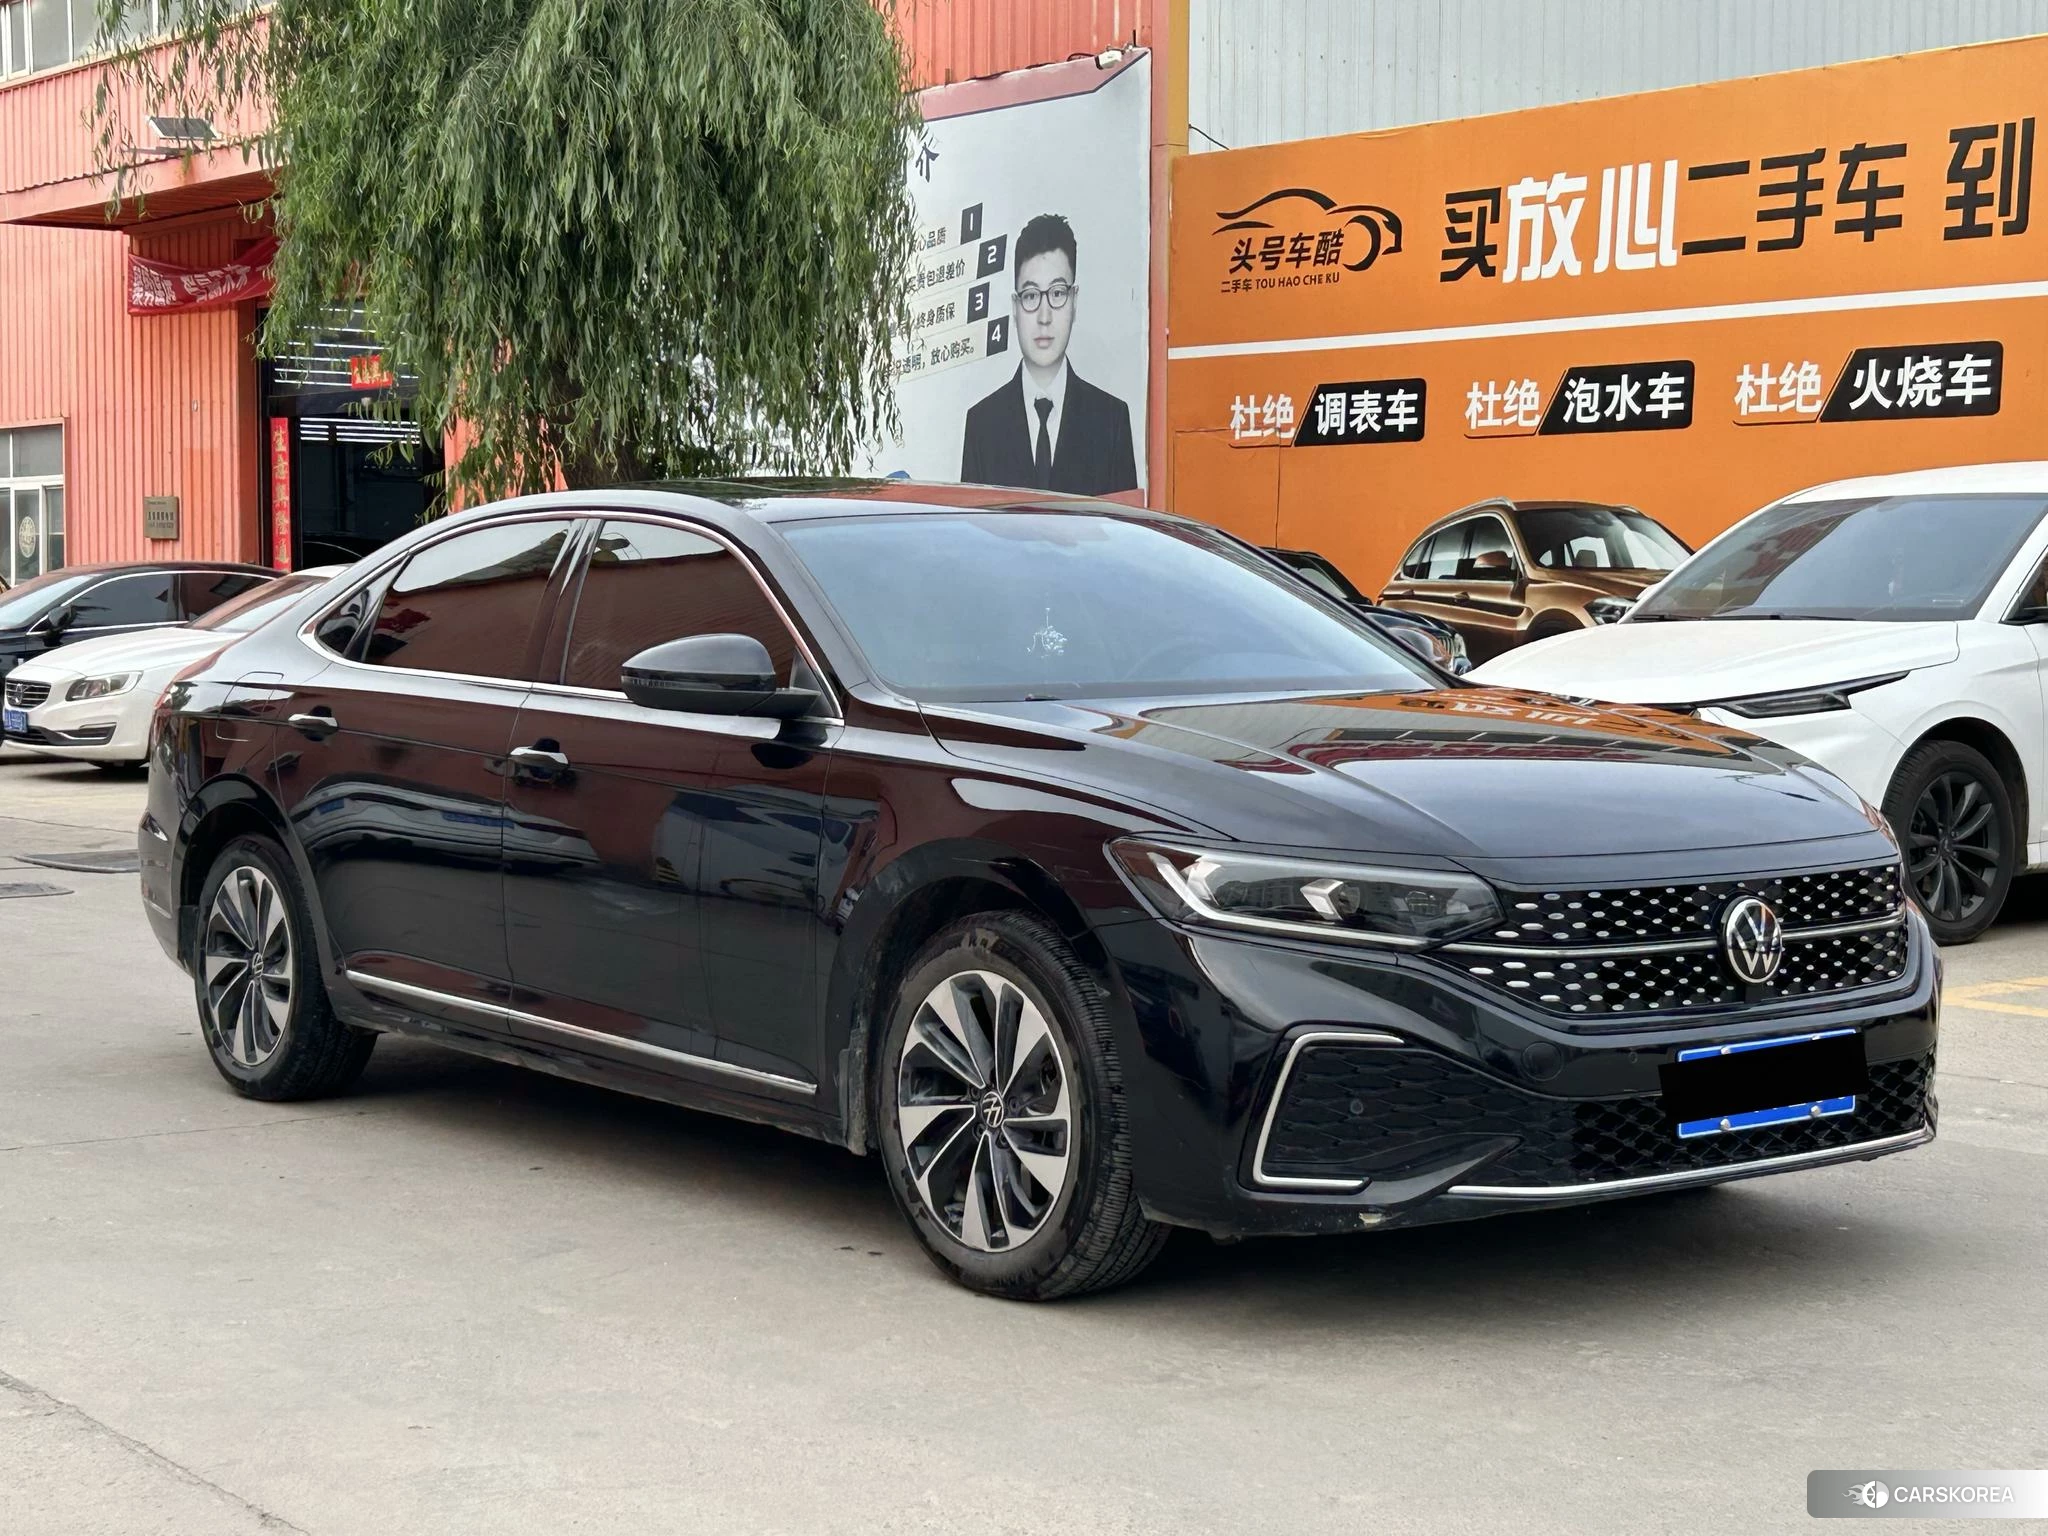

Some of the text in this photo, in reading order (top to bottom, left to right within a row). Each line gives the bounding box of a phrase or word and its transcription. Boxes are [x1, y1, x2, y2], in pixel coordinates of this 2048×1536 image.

[1943, 117, 2035, 241] 到
[987, 244, 997, 265] 2
[1229, 228, 1345, 275] 头号车酷
[975, 292, 984, 312] 3
[1221, 278, 1253, 294] 二手车
[1256, 278, 1276, 290] TOU
[1278, 275, 1301, 288] HAO
[1303, 273, 1324, 286] CHE
[991, 323, 1002, 342] 4
[1464, 371, 1686, 430] 杜绝 泡水车
[1734, 353, 1993, 416] 杜绝 火烧车
[1230, 388, 1419, 440] 杜绝 调表车
